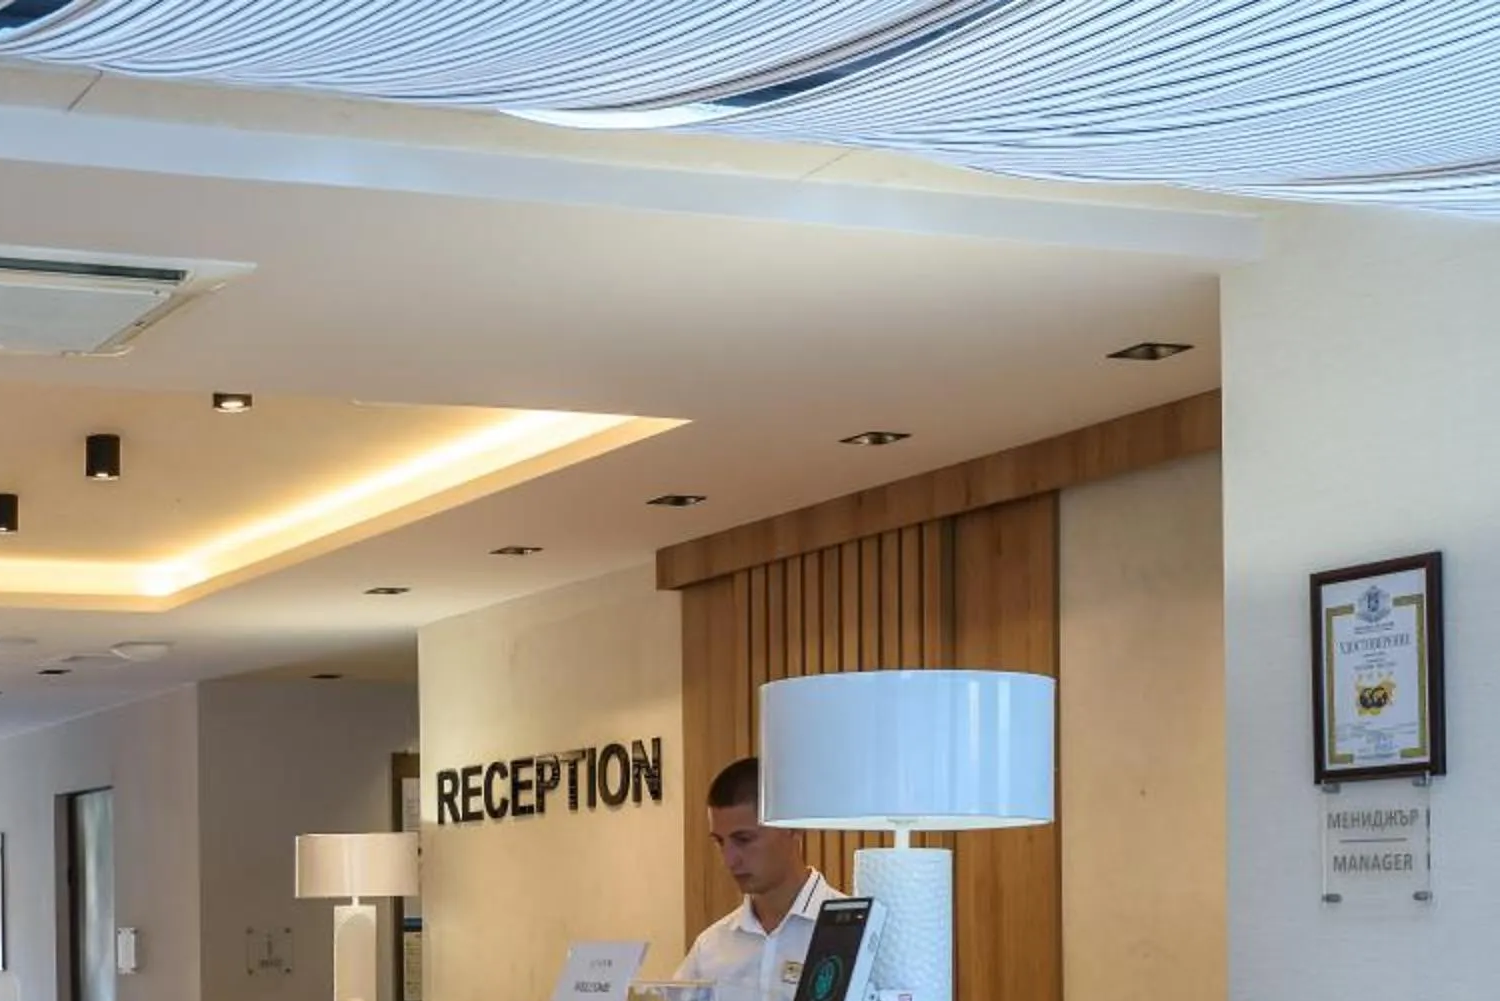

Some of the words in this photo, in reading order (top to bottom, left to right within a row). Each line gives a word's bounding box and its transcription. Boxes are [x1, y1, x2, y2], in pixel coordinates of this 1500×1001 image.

[436, 737, 663, 825] RECEPTION
[1326, 809, 1419, 832] МЕНИДЖЪР
[1333, 852, 1414, 873] MANAGER
